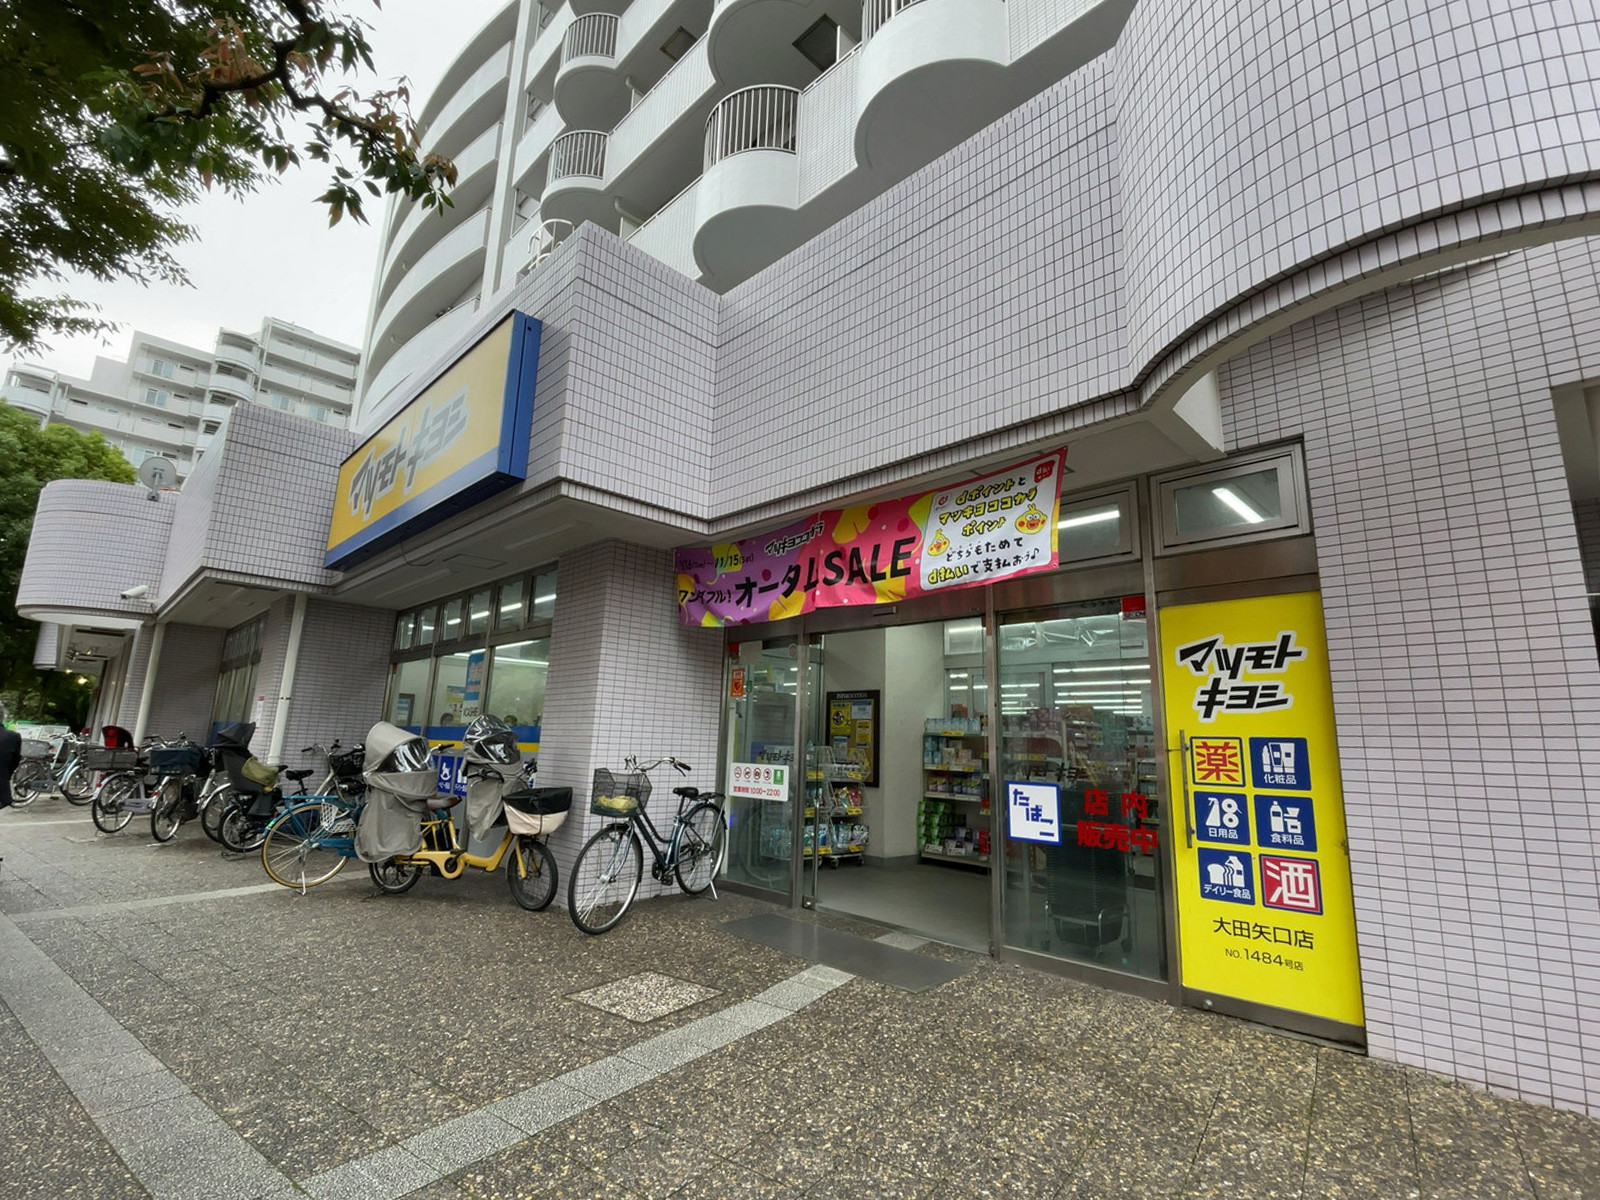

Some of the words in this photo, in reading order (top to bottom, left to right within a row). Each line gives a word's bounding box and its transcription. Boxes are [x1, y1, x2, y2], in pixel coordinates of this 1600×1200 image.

[350, 390, 468, 516] マツモトキヨシ
[938, 485, 1039, 526] マツキヨココカラ
[954, 476, 1027, 506] dポイントと
[961, 516, 1007, 537] ポイント
[945, 536, 1024, 562] どちらもためて
[1179, 634, 1303, 680] マツモト
[1197, 676, 1289, 719] キヨシ
[1195, 741, 1239, 782] 薬
[1263, 773, 1297, 785] 化粧品
[1013, 788, 1055, 837] たばこ
[1083, 787, 1148, 819] 店内
[1076, 820, 1158, 854] 販売中
[1208, 827, 1239, 839] 日用品
[1270, 832, 1304, 846] 食料品
[1204, 884, 1251, 900] デイリー食品
[1265, 860, 1316, 908] 酒
[1212, 916, 1314, 950] 大田矢口店
